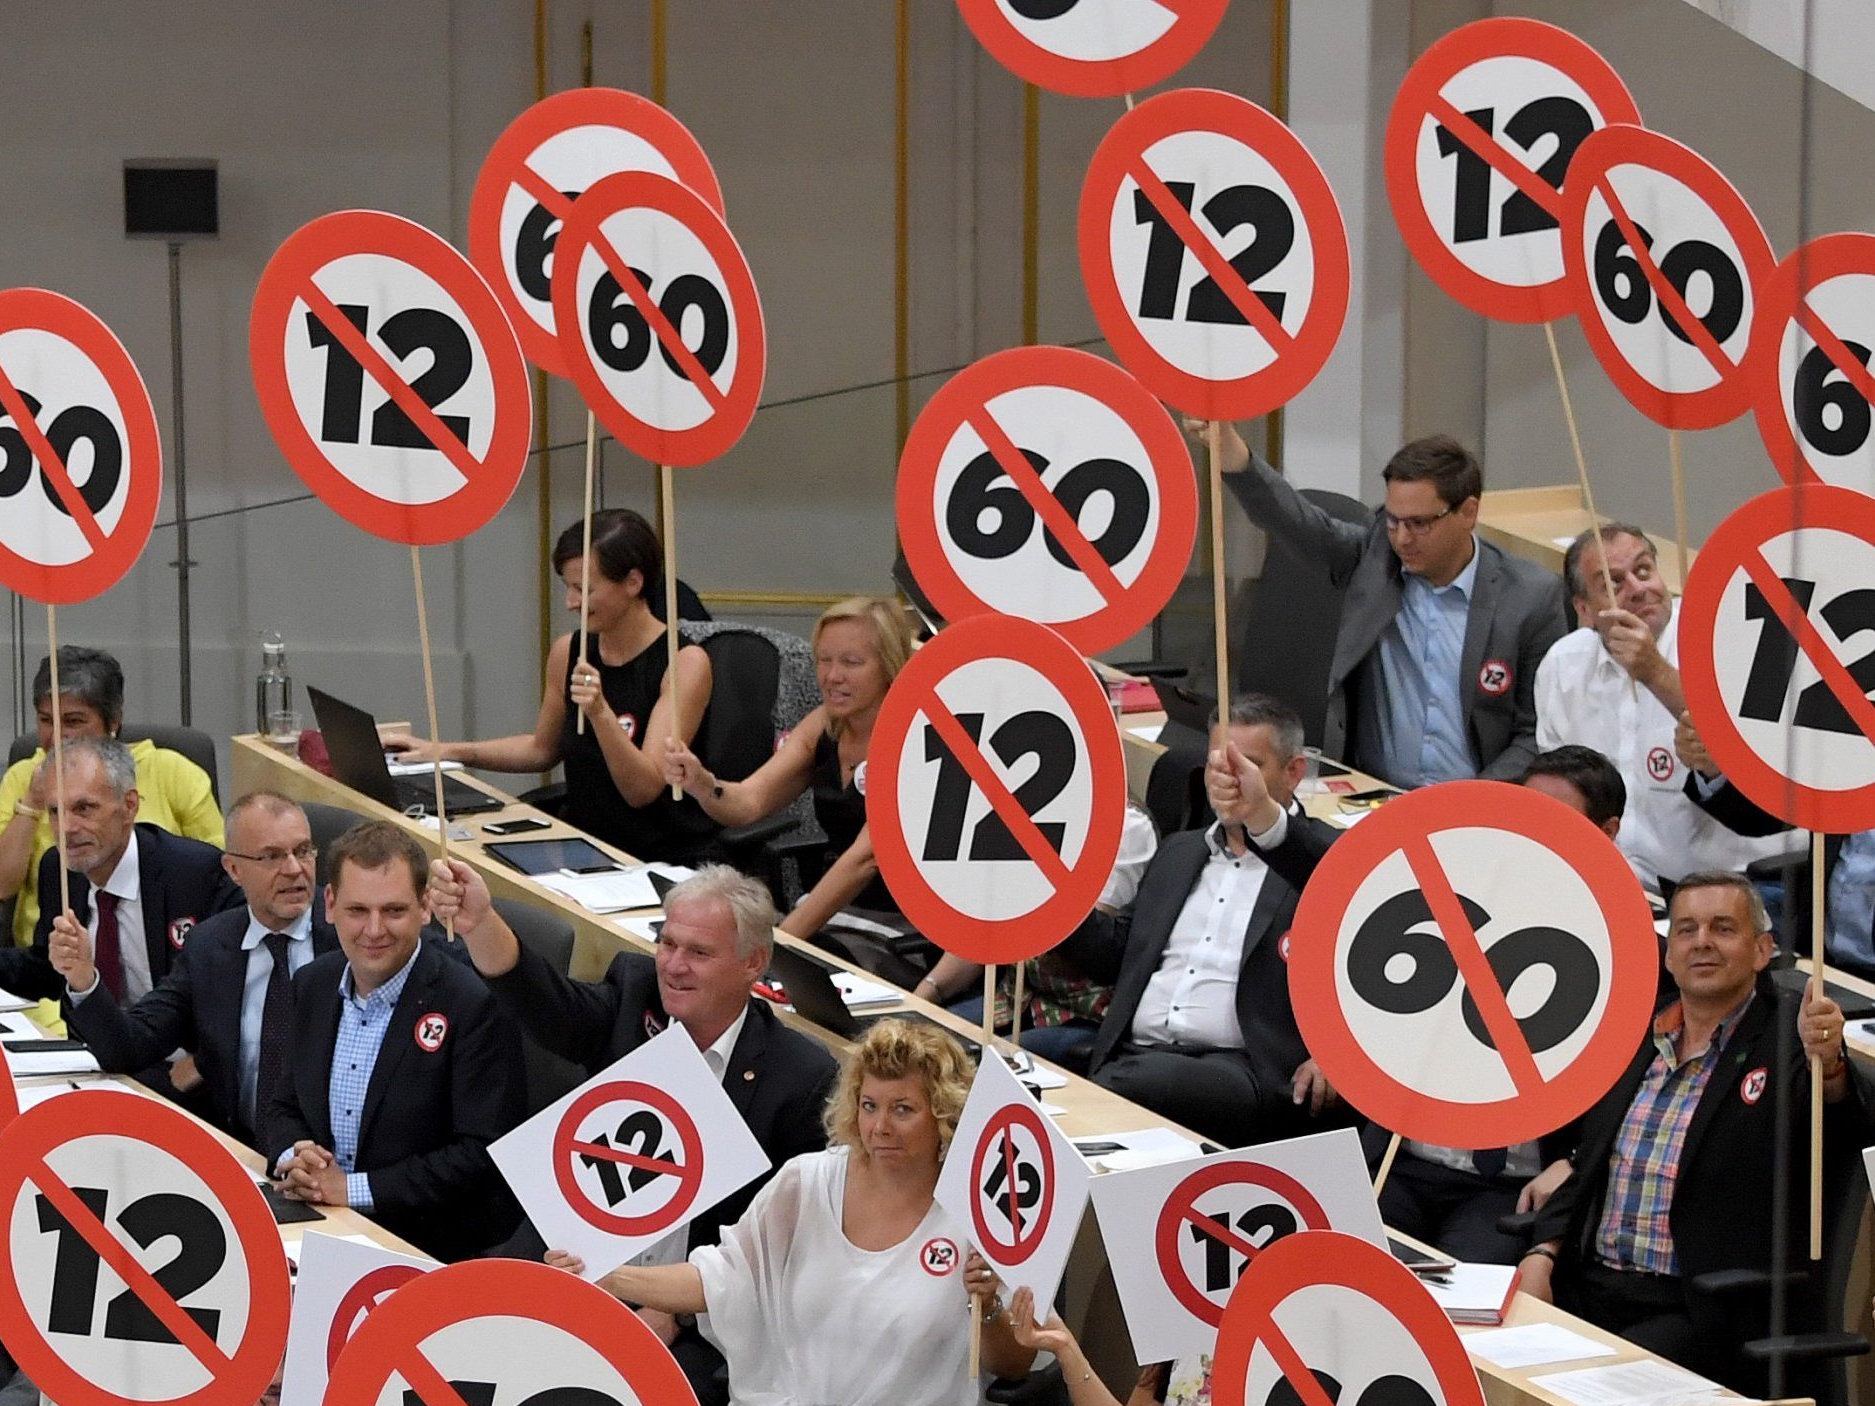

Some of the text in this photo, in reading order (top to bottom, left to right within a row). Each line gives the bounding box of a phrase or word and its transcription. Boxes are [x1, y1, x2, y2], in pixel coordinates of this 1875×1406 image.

[1436, 97, 1594, 243] 12
[516, 191, 583, 301] 6
[1134, 182, 1294, 325] 12
[1595, 219, 1743, 346] 60
[306, 304, 472, 450] 12
[589, 268, 728, 380] 60
[1794, 340, 1872, 456] 6
[947, 449, 1150, 571] 60
[1484, 671, 1506, 688] 12
[1739, 578, 1875, 736] 12
[923, 711, 1076, 861] 12
[1652, 755, 1670, 773] 12
[1347, 889, 1600, 1053] 60
[422, 1024, 444, 1042] 12
[580, 1111, 675, 1207] 12
[984, 1138, 1041, 1230] 12
[35, 1187, 226, 1344] 12
[928, 1247, 953, 1266] 12
[1190, 1204, 1297, 1292] 12
